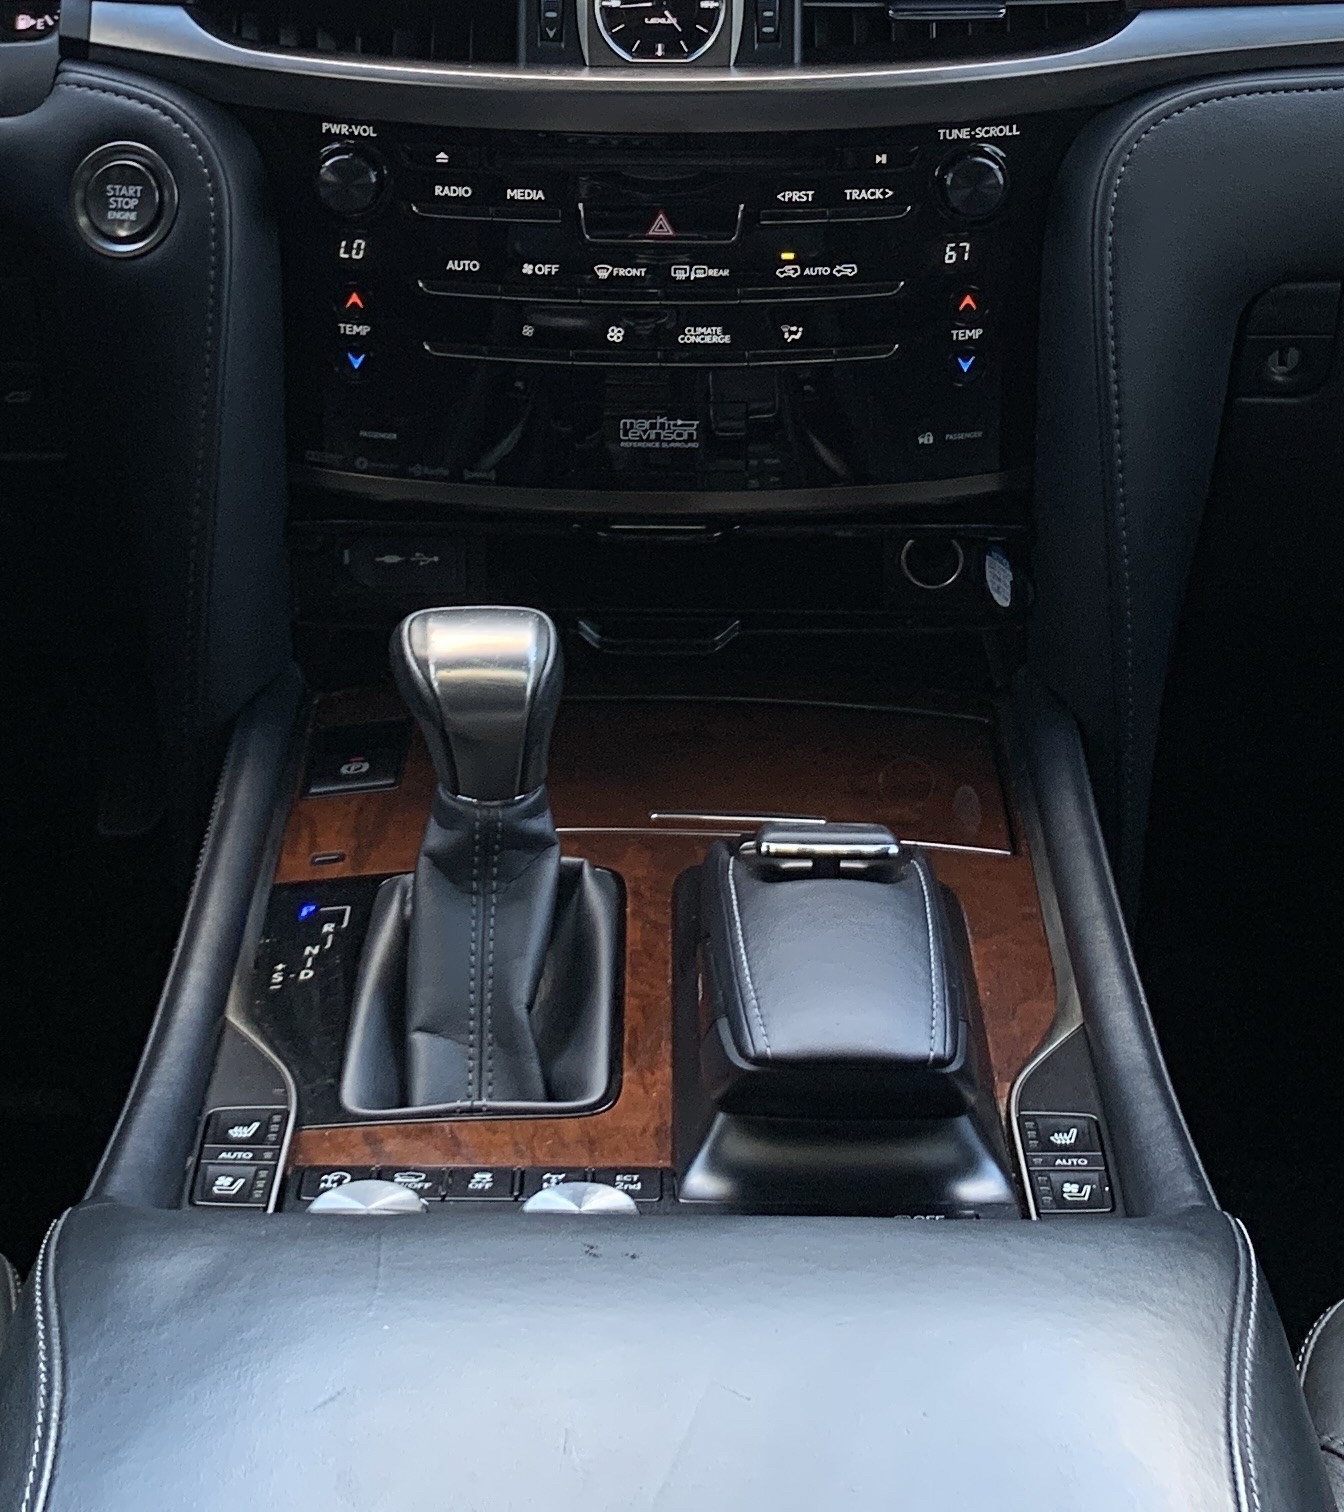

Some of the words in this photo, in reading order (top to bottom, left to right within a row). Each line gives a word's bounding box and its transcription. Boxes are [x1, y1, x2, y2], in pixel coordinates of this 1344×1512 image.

[106, 184, 143, 198] START
[434, 185, 473, 198] RADIO
[506, 188, 545, 201] MEDIA
[109, 197, 139, 209] STOP
[107, 210, 138, 221] ENGINE
[944, 242, 971, 264] 67
[446, 259, 480, 272] AUTO
[535, 264, 560, 276] OFF
[803, 266, 831, 276] AUTO
[613, 267, 647, 278] FRONT
[707, 267, 730, 278] REAR
[338, 323, 371, 336] TEMP
[684, 326, 723, 336] CLIMATE
[950, 328, 984, 341] TEMP
[677, 334, 732, 345] CONCIERGE
[322, 923, 336, 934] R
[304, 945, 321, 956] N
[271, 971, 284, 983] S
[299, 969, 315, 981] D
[217, 1151, 254, 1159] AUTO
[1054, 1158, 1089, 1166] AUTO
[615, 1174, 640, 1182] ECT
[467, 1181, 494, 1190] OFF
[614, 1181, 642, 1190] 2nd
